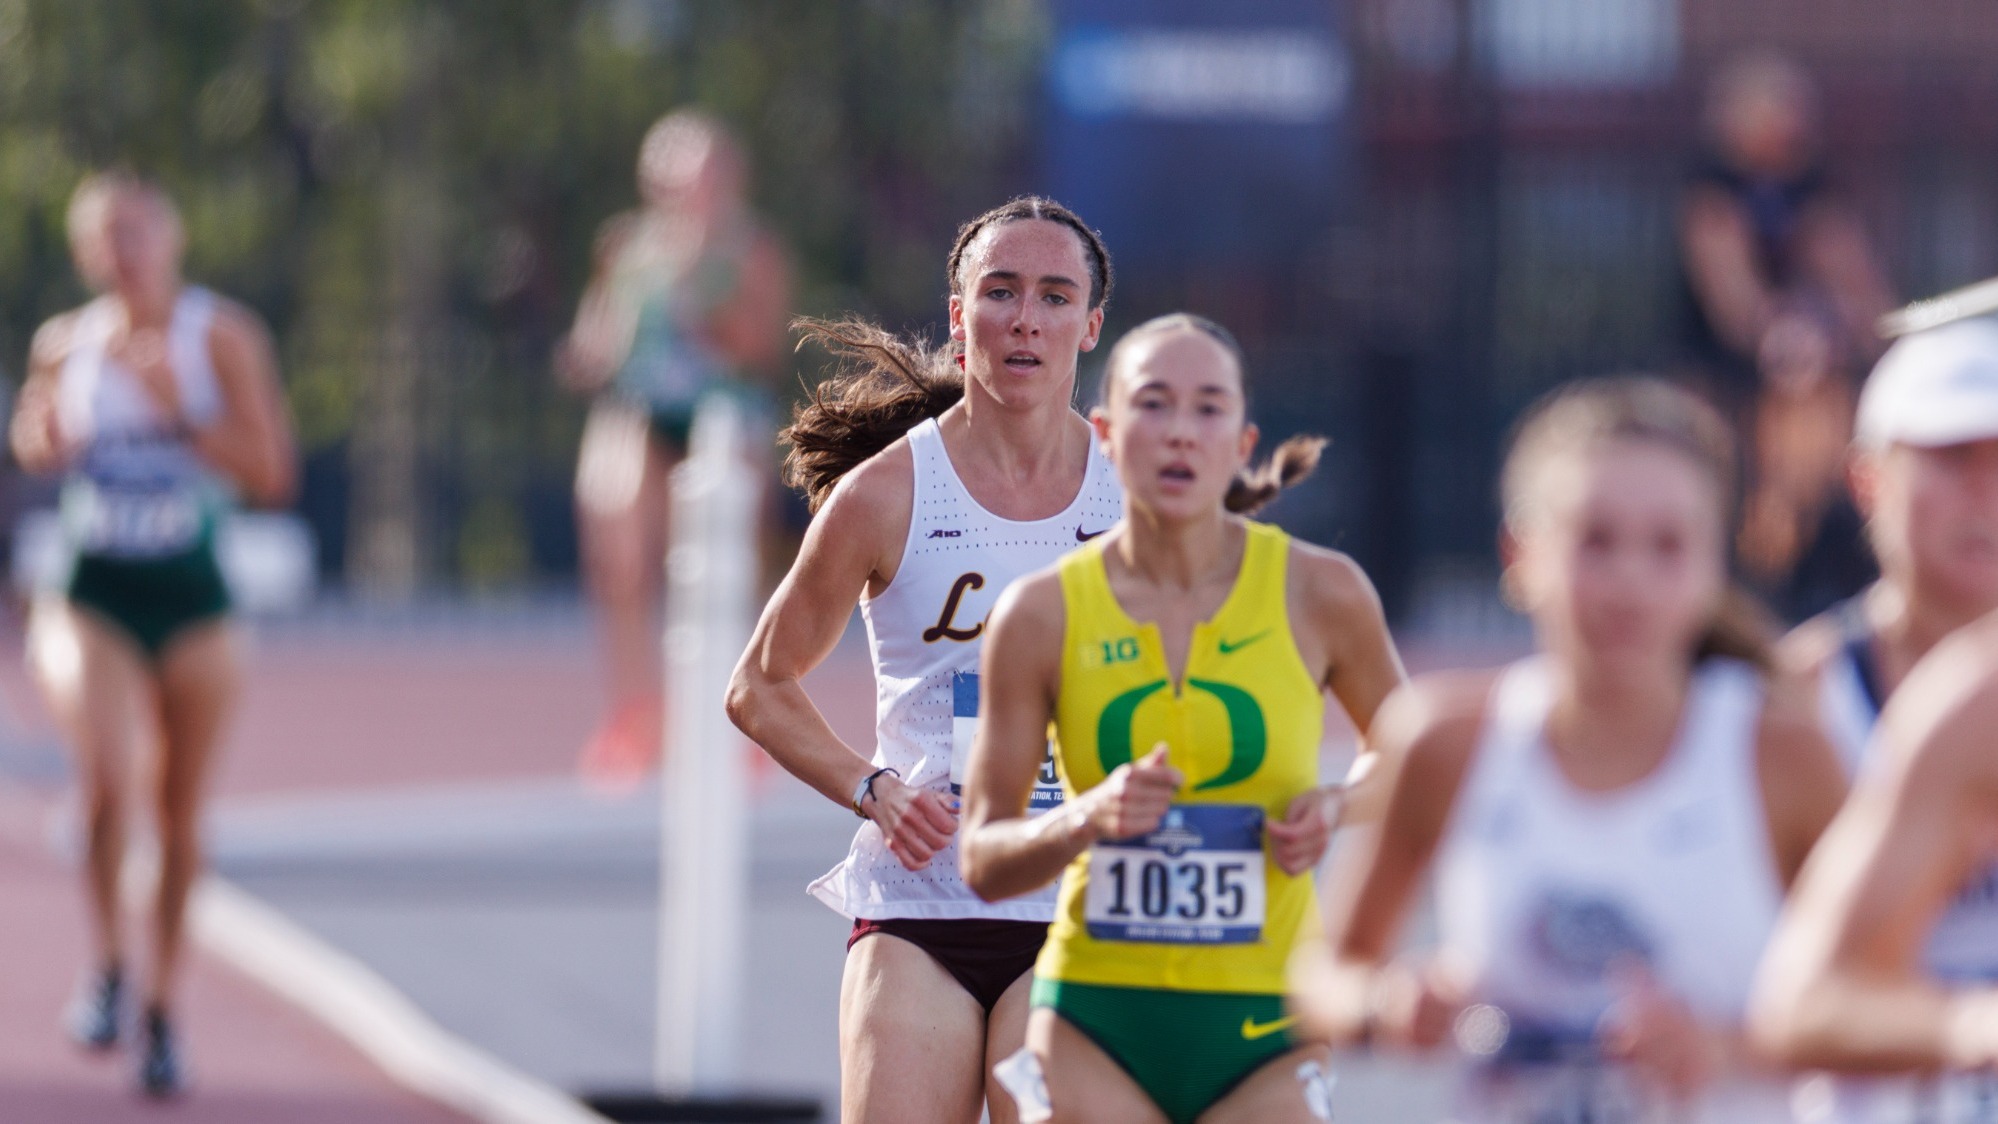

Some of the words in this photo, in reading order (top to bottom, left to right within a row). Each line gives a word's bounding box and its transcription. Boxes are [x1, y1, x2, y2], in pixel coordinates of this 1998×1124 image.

[927, 529, 961, 539] A10
[922, 572, 991, 643] L
[1029, 791, 1053, 801] ATION,
[1107, 857, 1246, 919] 1035
